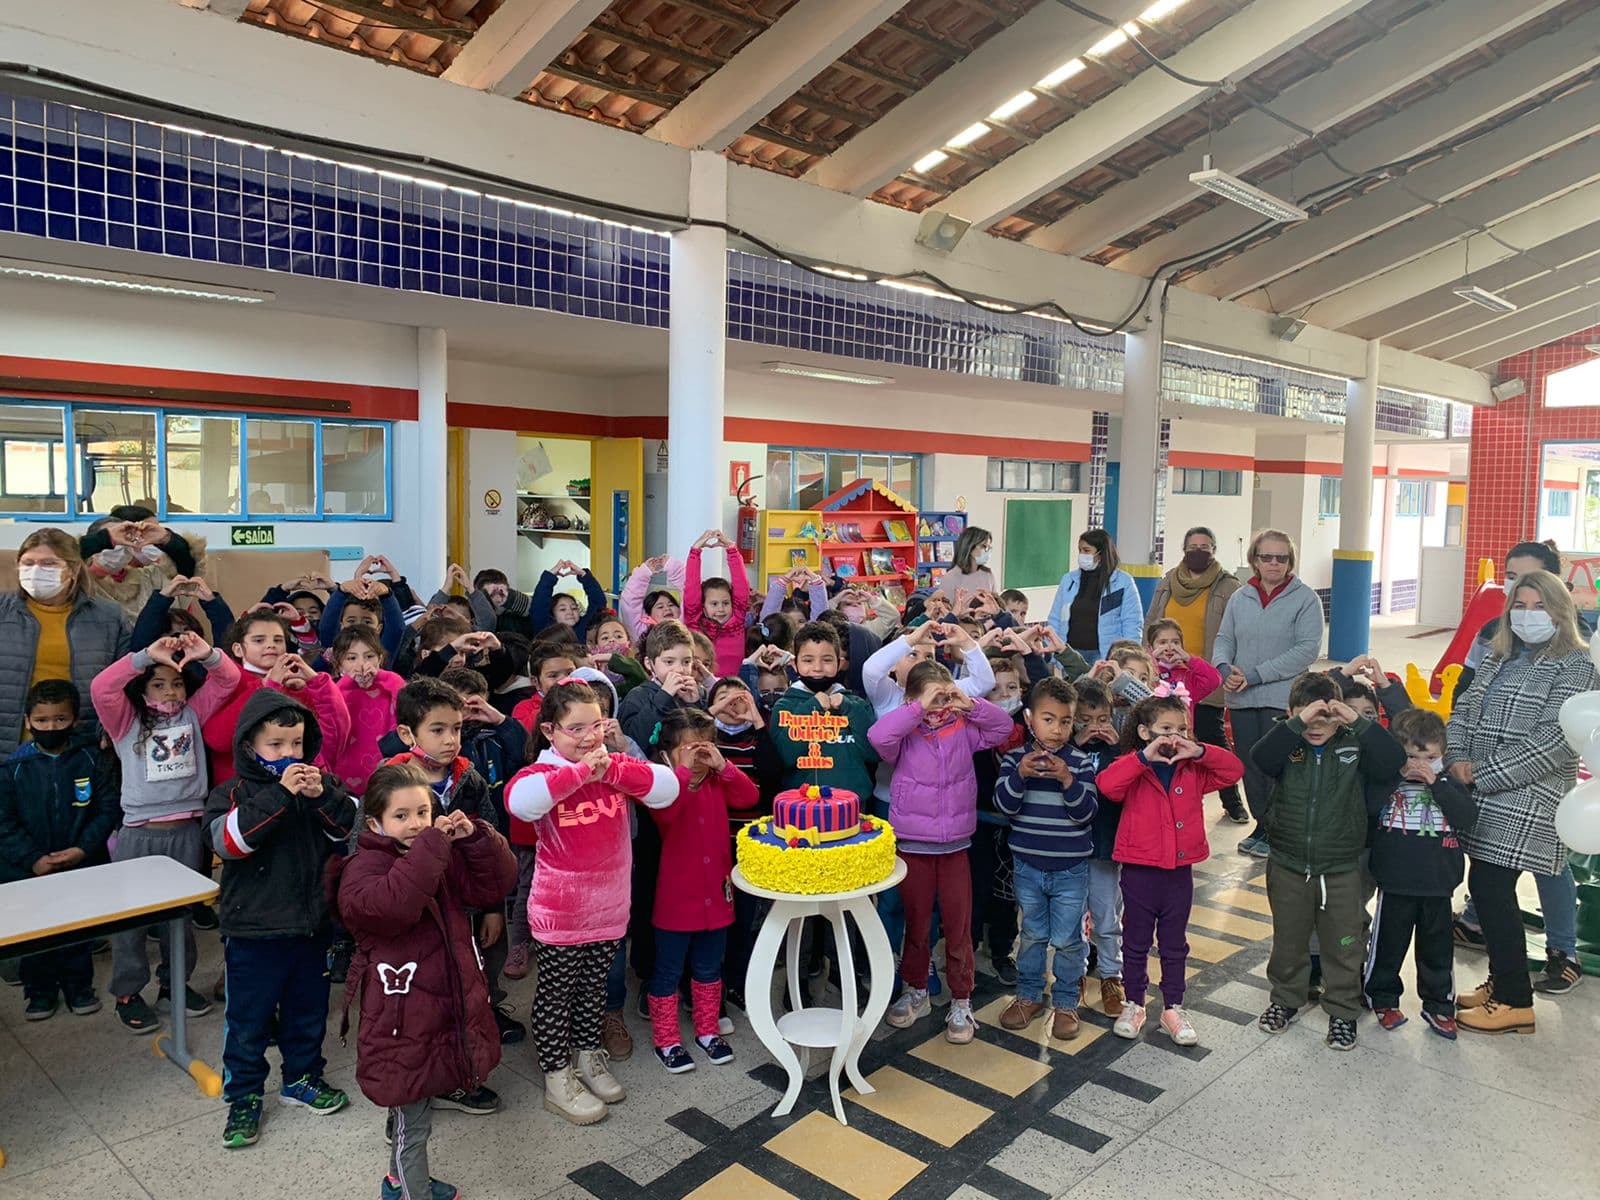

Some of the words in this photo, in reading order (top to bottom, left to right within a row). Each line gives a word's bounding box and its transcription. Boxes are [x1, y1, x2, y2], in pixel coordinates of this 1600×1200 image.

[245, 526, 273, 544] SAÍDA
[778, 710, 849, 728] Parabéns
[808, 741, 821, 758] 8
[796, 756, 834, 769] anos
